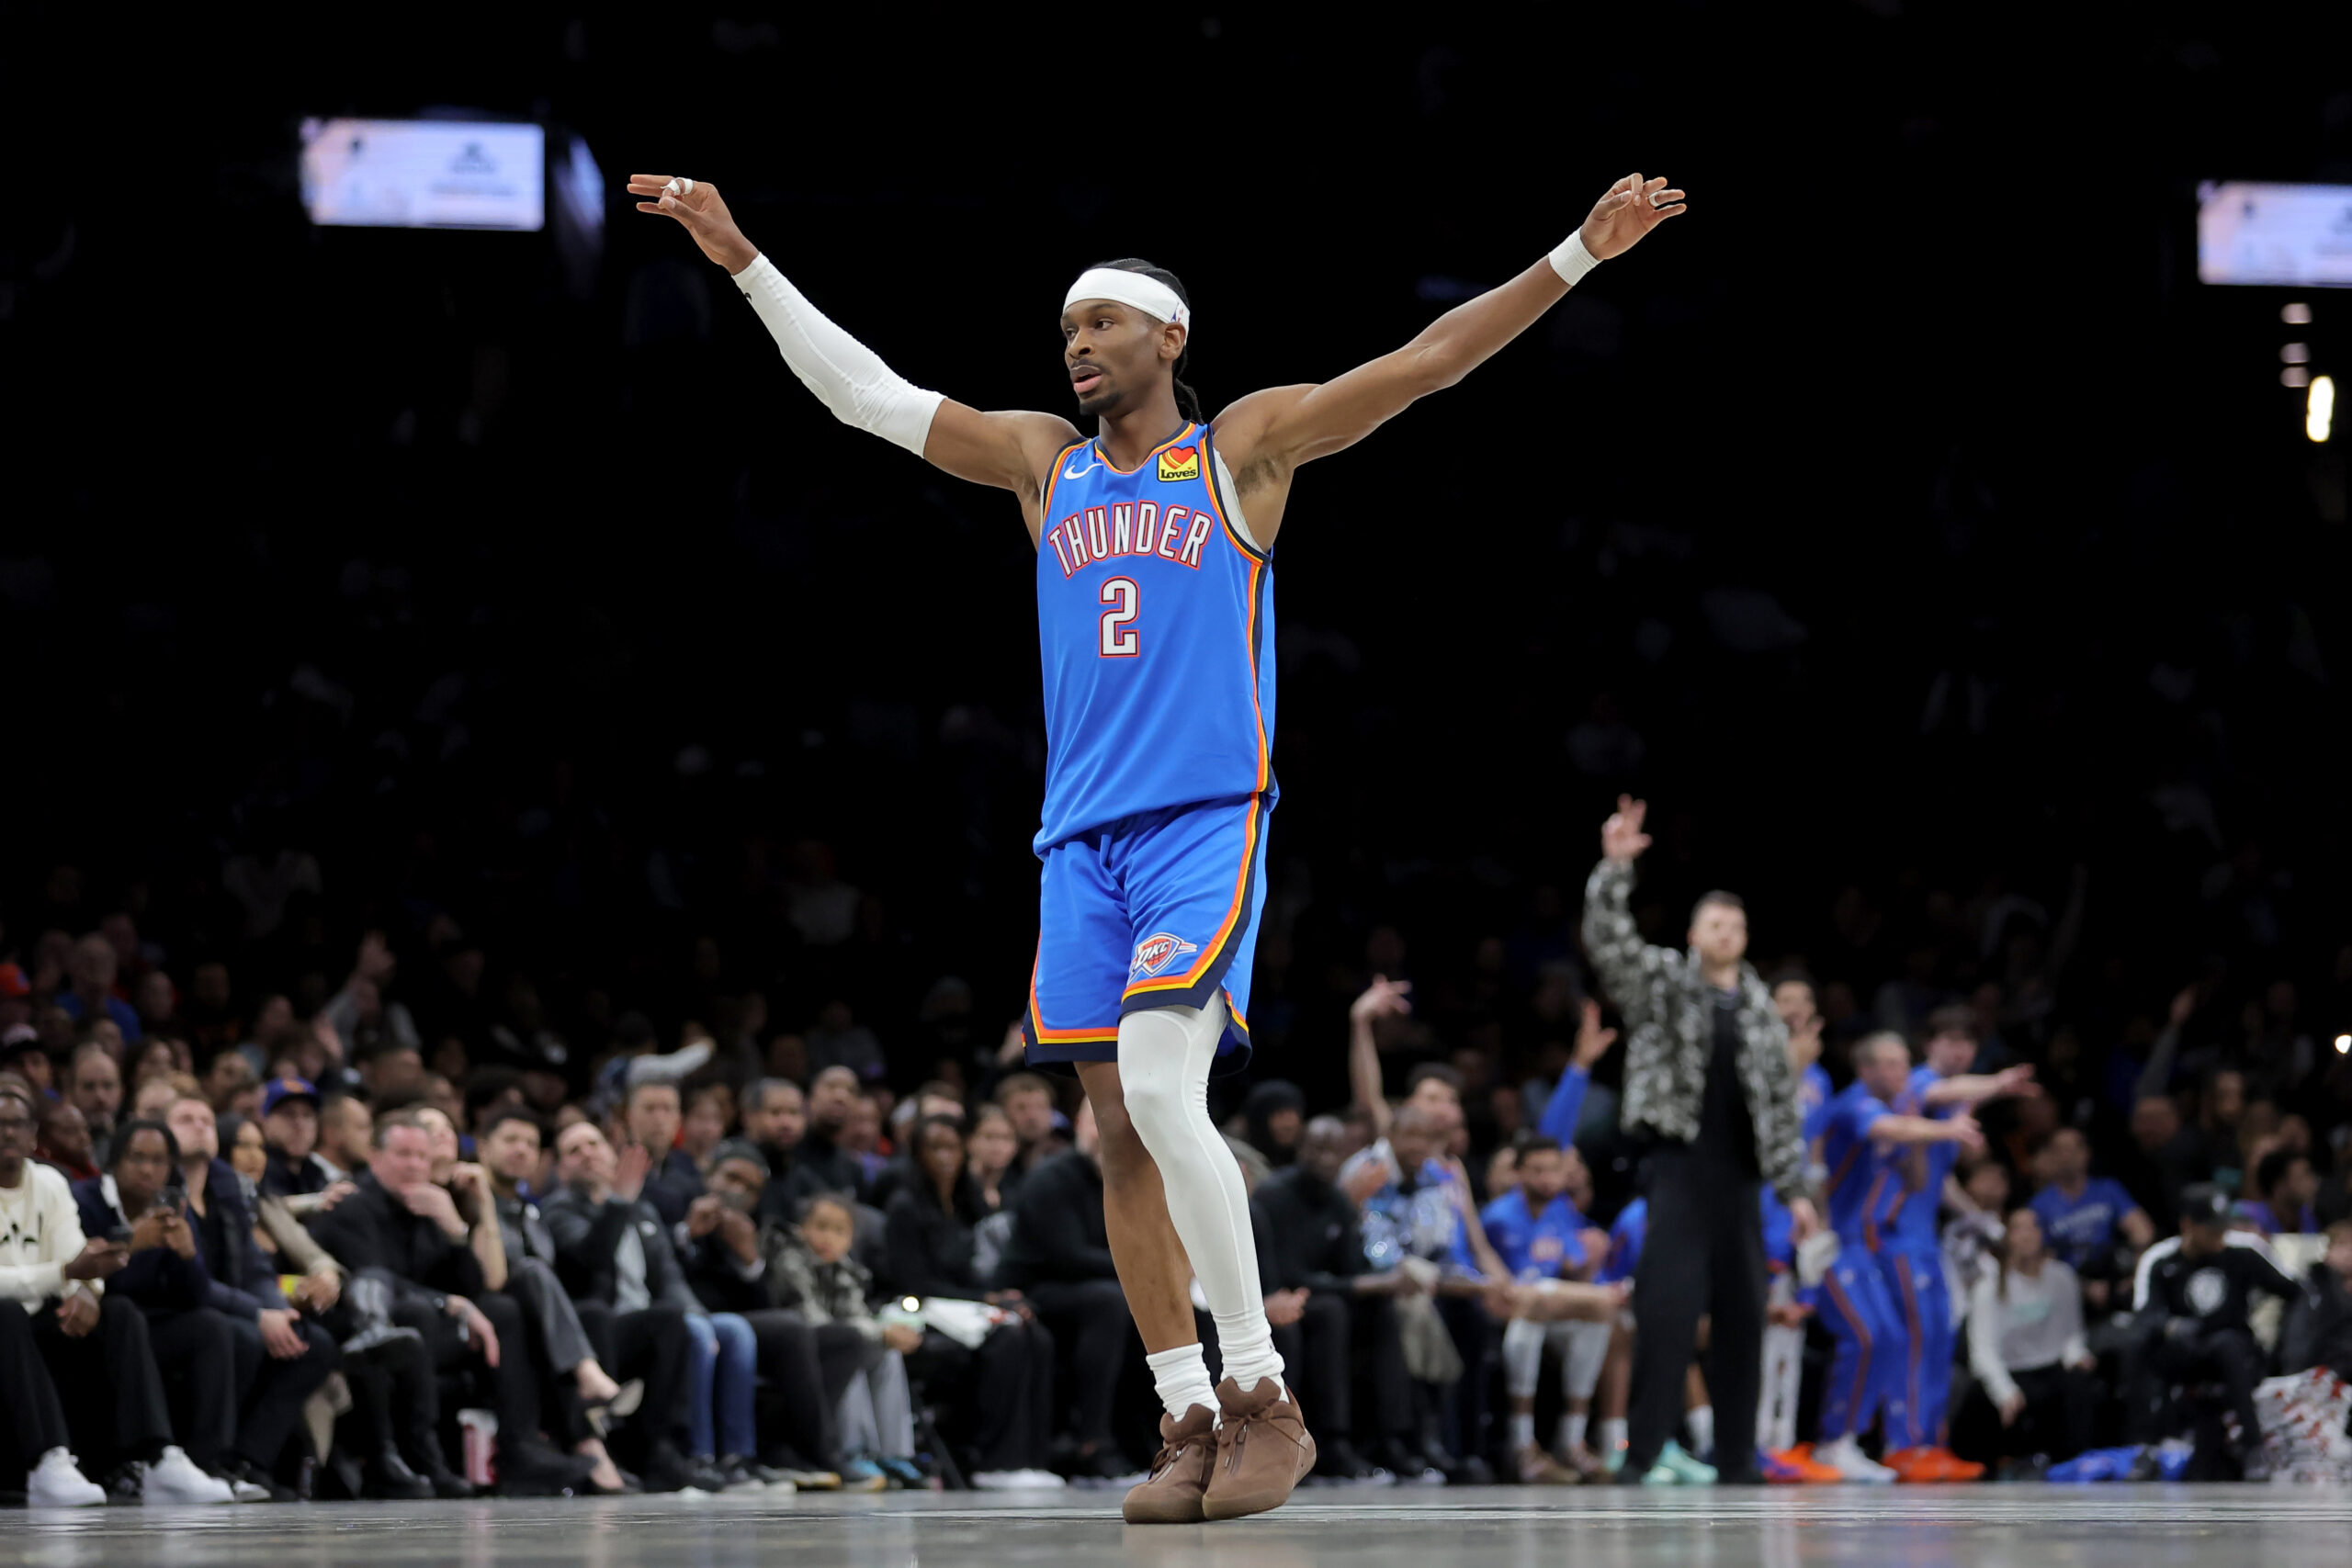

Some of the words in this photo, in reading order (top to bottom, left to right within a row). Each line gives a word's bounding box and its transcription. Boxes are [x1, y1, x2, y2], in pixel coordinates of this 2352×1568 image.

[1048, 501, 1213, 579] THUNDER
[1100, 576, 1139, 658] 2
[1134, 941, 1170, 970] OKC
